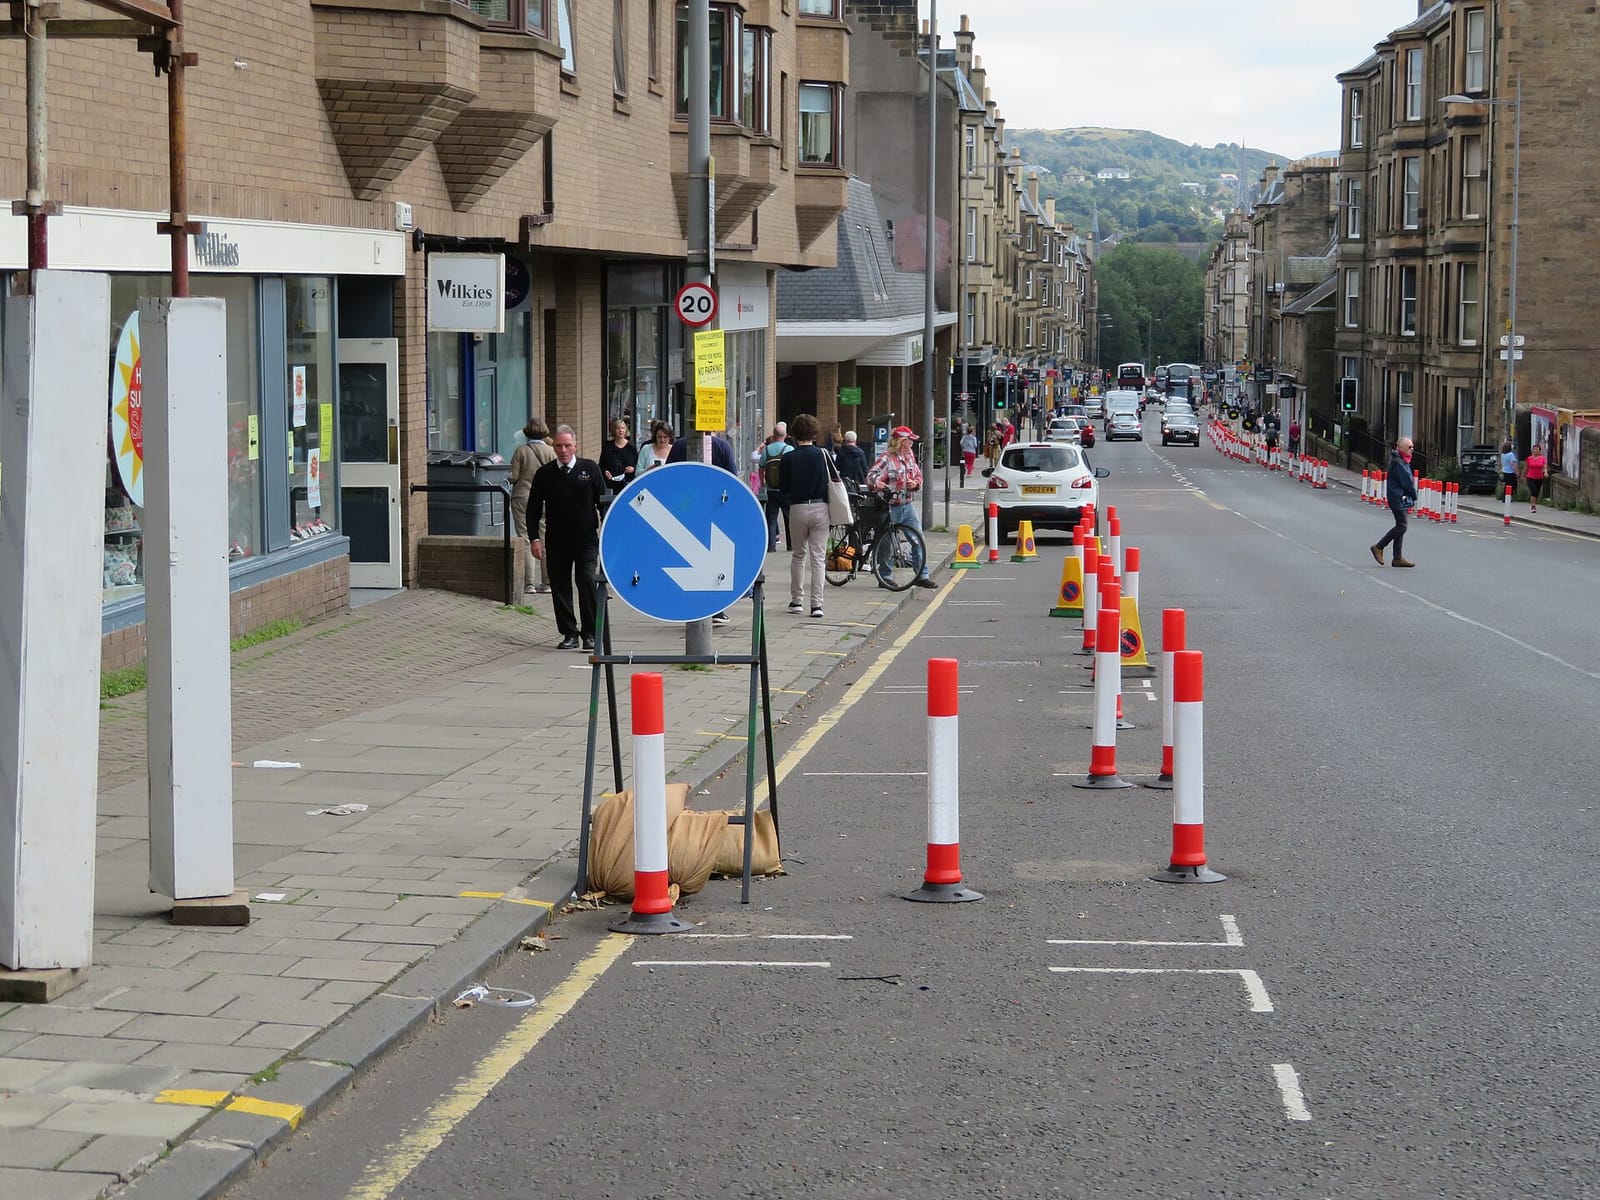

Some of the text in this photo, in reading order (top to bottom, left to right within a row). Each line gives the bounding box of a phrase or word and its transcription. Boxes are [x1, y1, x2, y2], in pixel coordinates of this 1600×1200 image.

[193, 222, 239, 267] Wilkies
[437, 280, 493, 299] Wilkies
[475, 300, 491, 308] 1898
[682, 295, 711, 313] 20
[698, 363, 723, 376] NO PARKING
[878, 427, 887, 440] P
